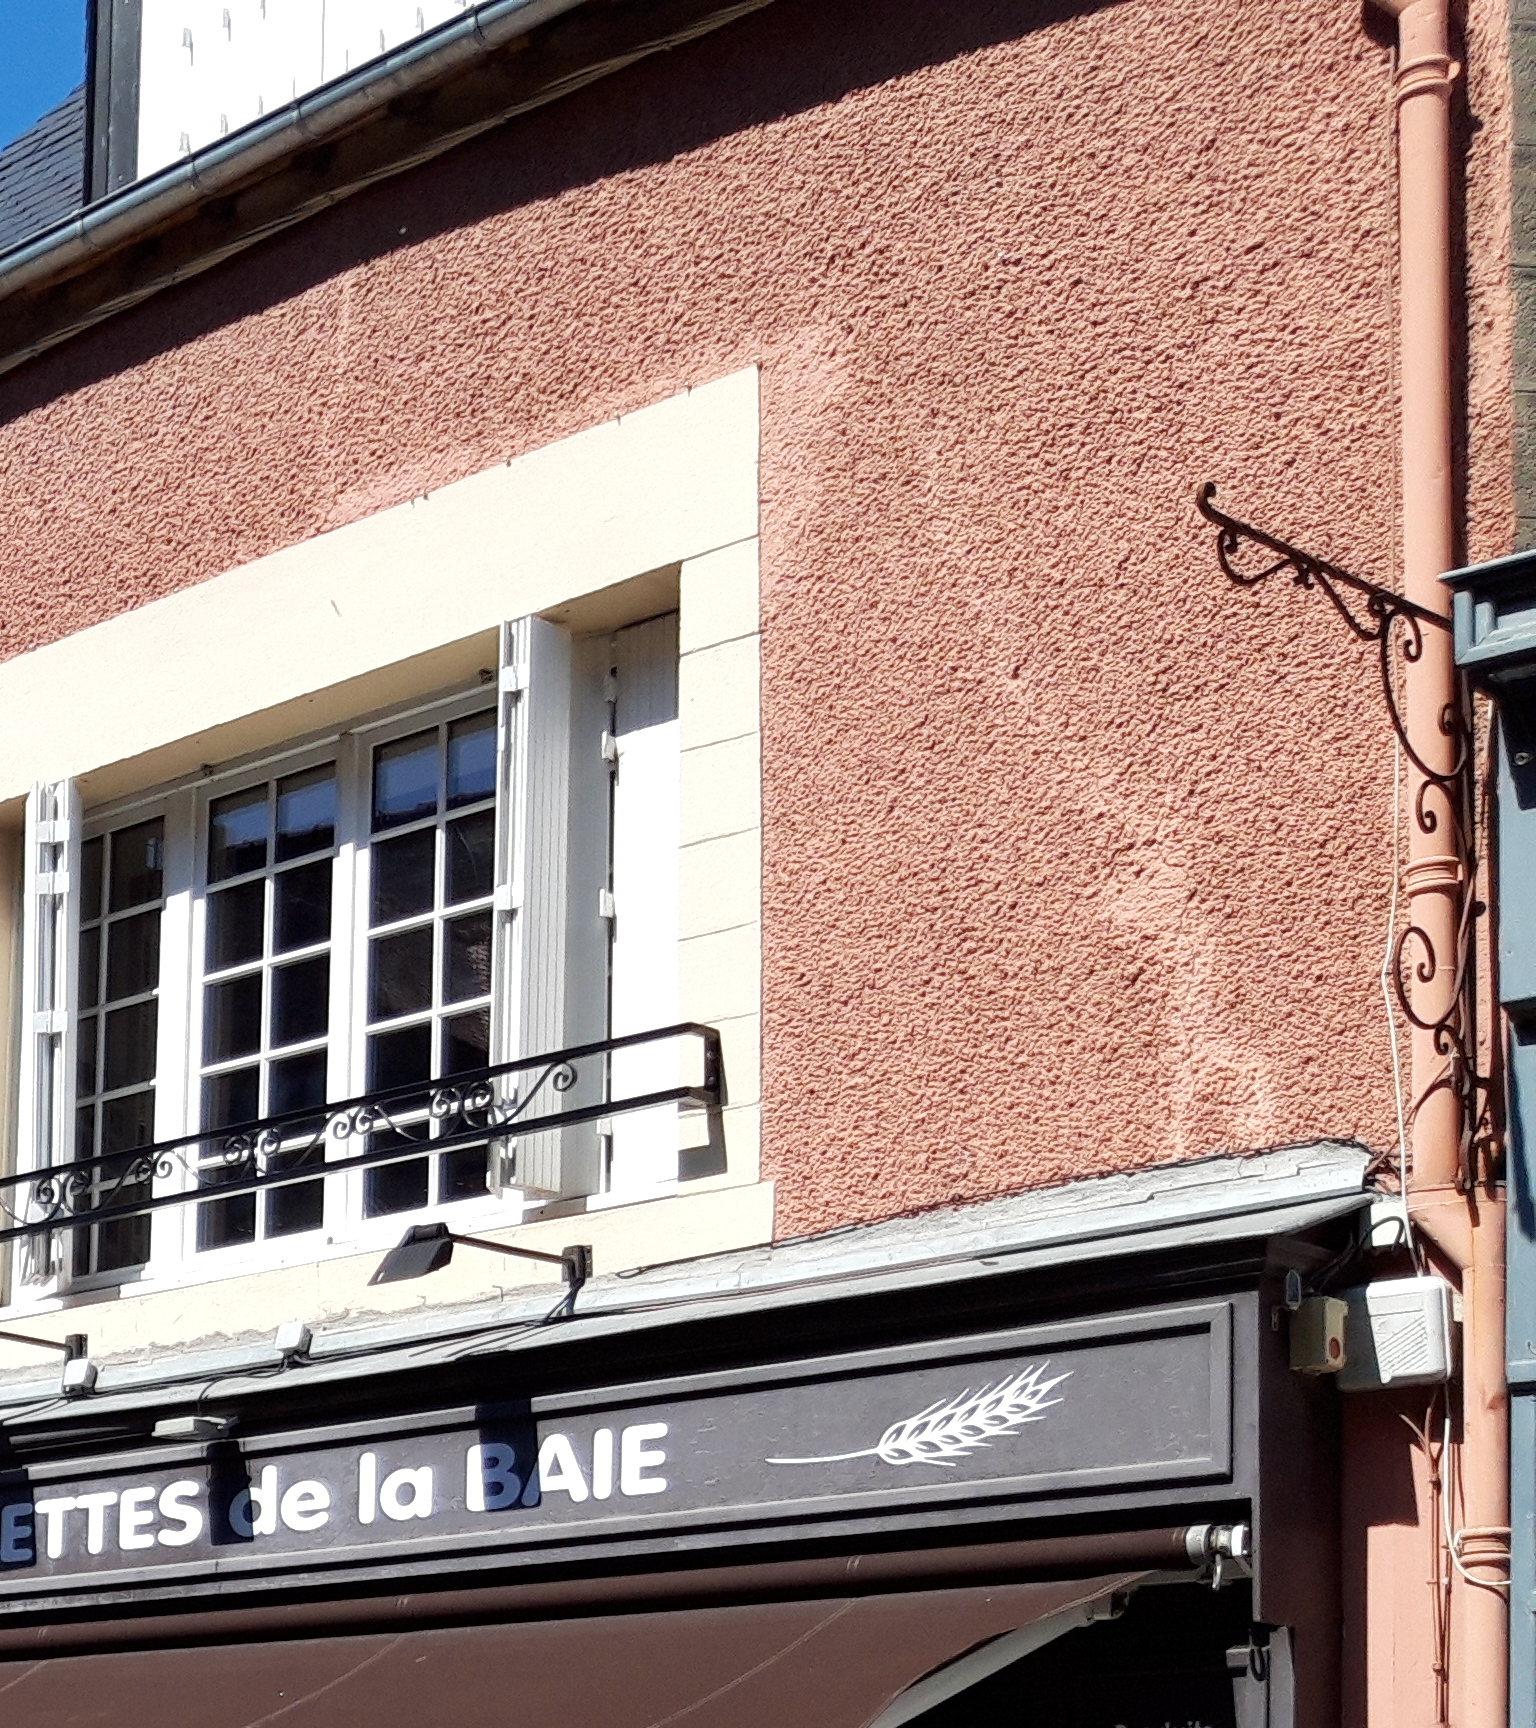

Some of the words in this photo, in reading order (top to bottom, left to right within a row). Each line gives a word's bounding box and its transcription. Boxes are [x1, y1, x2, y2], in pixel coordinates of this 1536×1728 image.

[228, 1465, 331, 1539] de
[356, 1452, 433, 1526] la
[466, 1421, 669, 1513] BAIE
